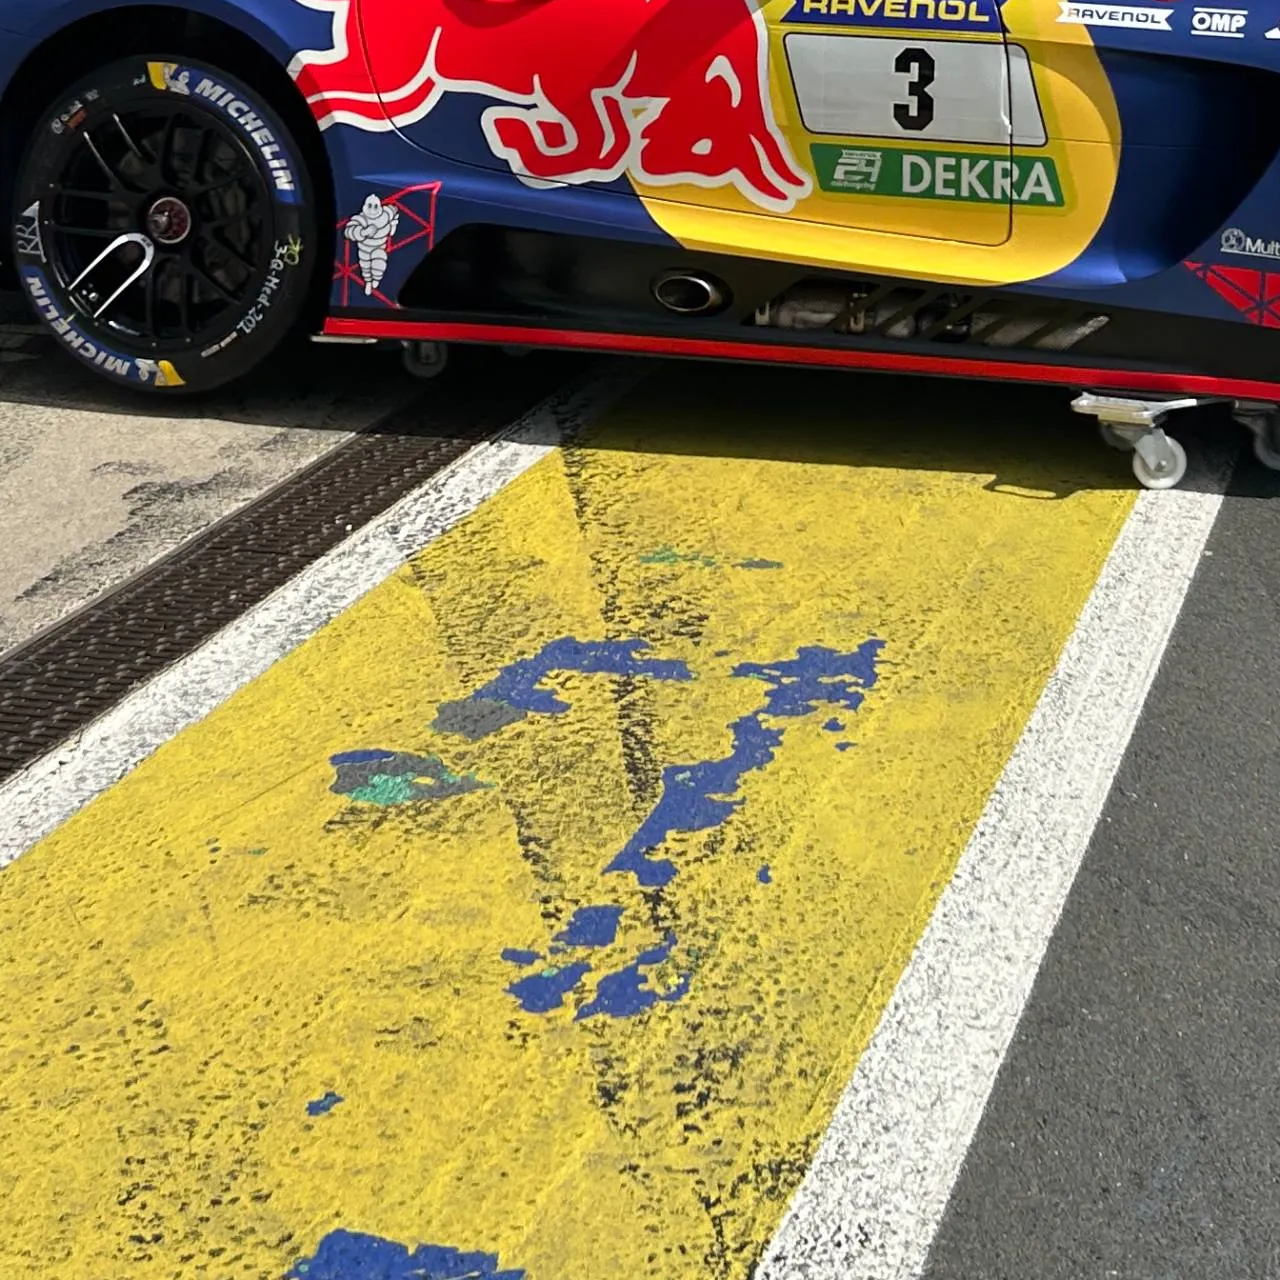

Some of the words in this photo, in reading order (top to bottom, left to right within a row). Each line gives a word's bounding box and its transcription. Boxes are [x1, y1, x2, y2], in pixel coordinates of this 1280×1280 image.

[1067, 7, 1162, 24] RAVENOL
[1191, 11, 1247, 33] OMP
[892, 47, 936, 131] 3
[194, 78, 295, 191] MICHELIN
[901, 154, 1056, 204] DEKRA
[26, 276, 131, 376] MICHELIN
